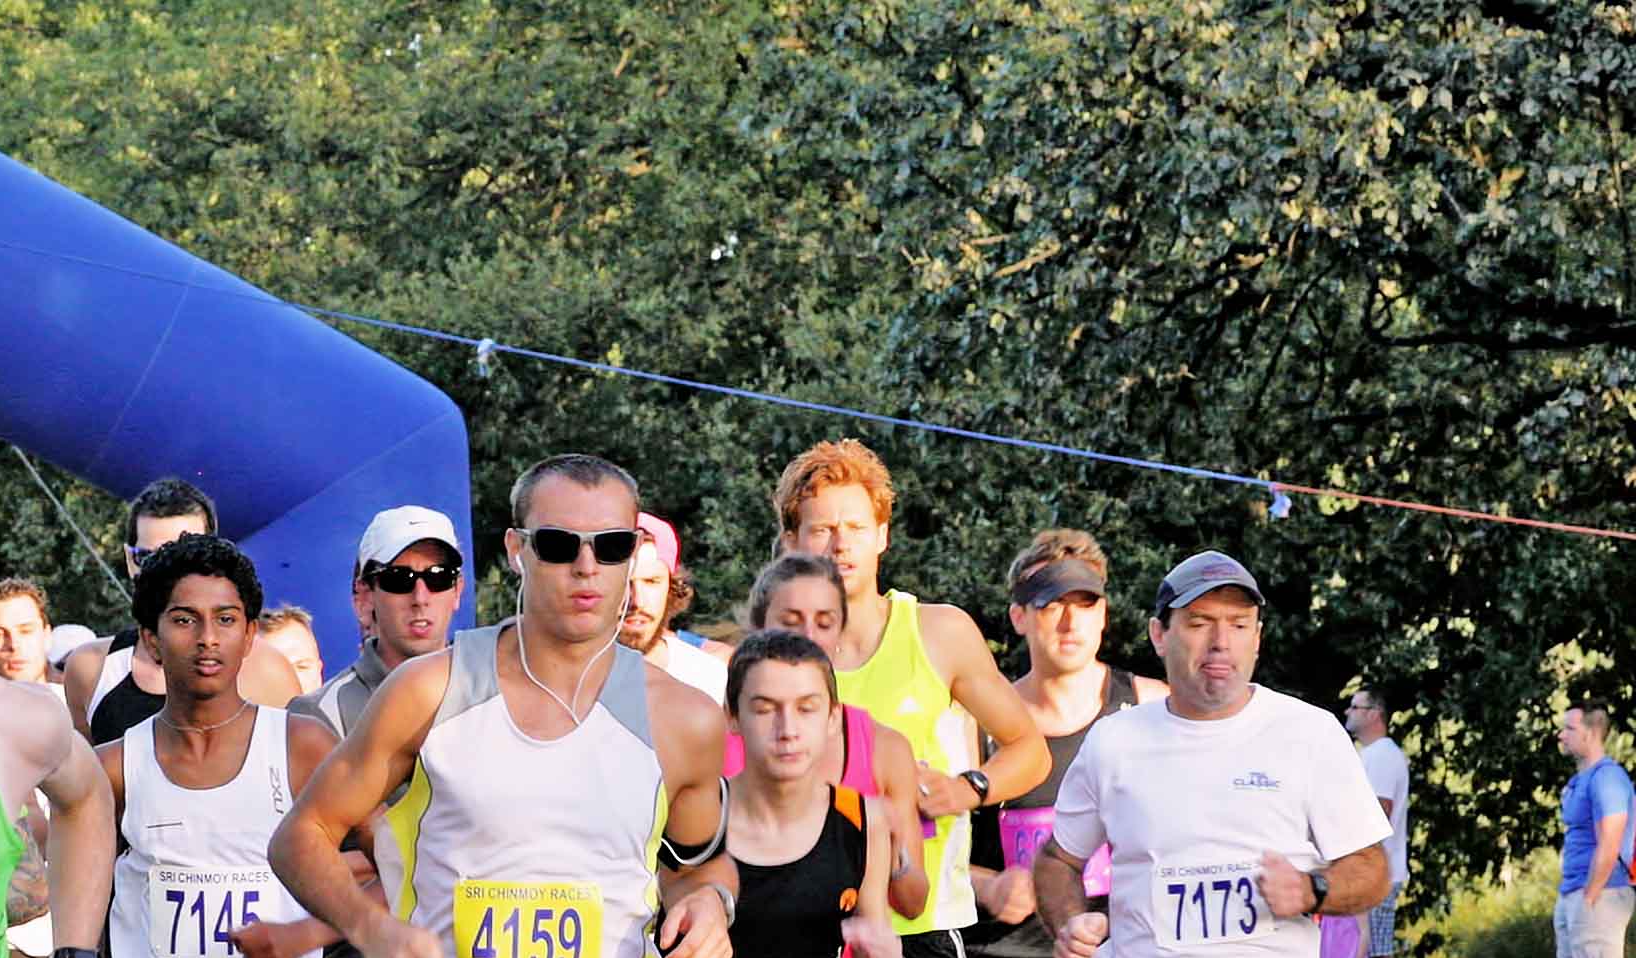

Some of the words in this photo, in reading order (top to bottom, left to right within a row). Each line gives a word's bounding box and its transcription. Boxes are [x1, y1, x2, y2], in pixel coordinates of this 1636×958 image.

[159, 871, 176, 882] SRI
[178, 872, 228, 884] CHINMOY
[232, 871, 270, 882] RACES
[466, 887, 485, 899] SRI
[488, 887, 547, 900] CHINMOY
[550, 888, 592, 900] RACES
[1167, 877, 1257, 940] 7173
